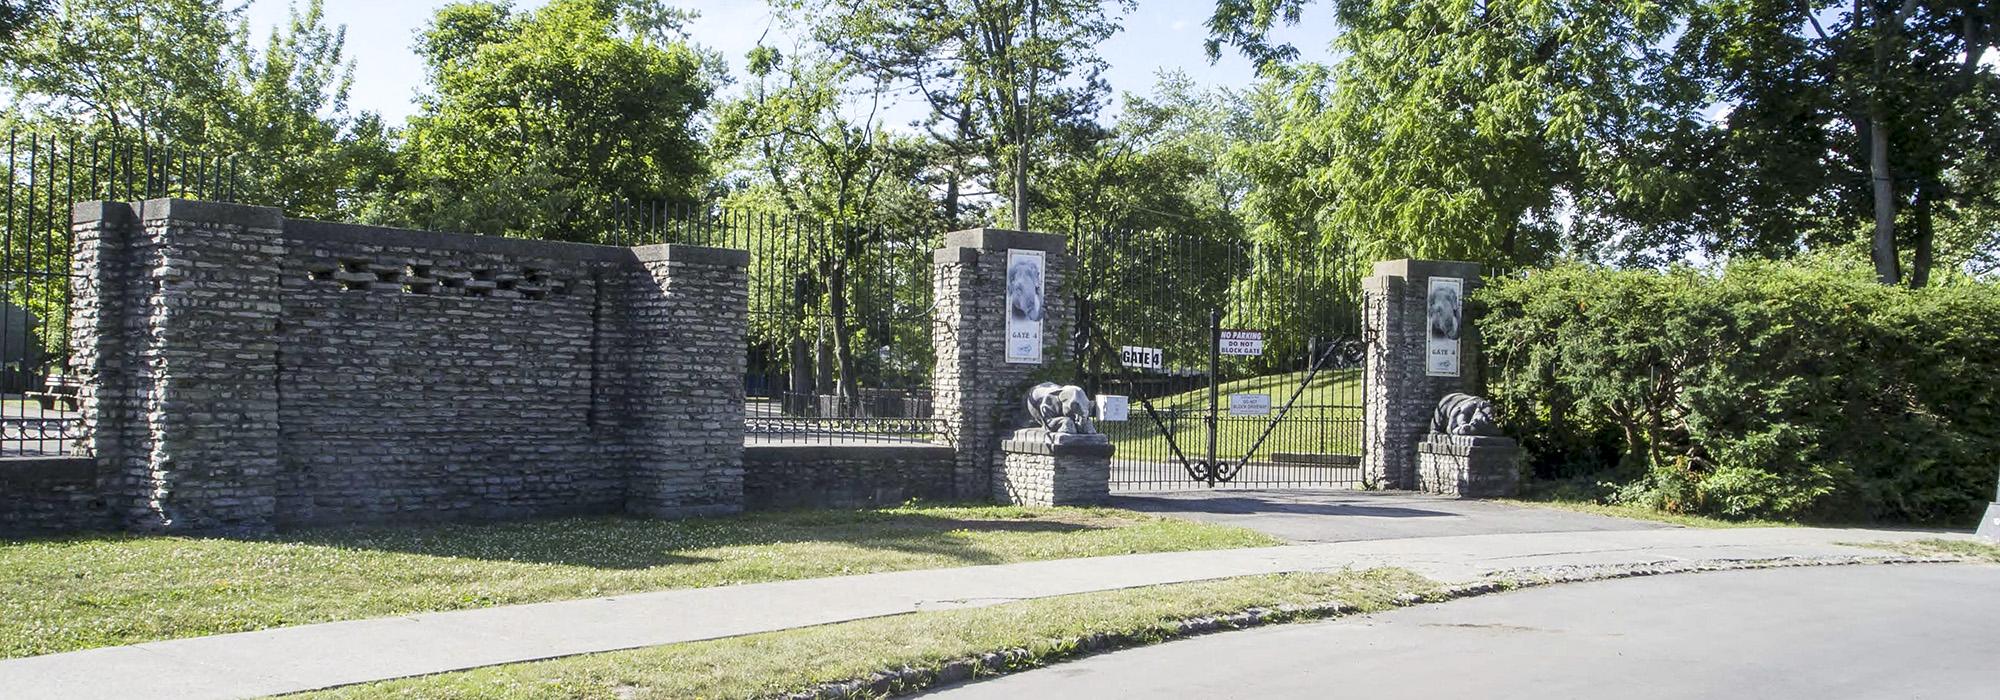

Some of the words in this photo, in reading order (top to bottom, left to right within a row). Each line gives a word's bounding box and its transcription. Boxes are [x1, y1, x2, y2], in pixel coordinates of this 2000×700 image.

[1220, 331, 1232, 339] NO
[1232, 331, 1262, 340] PARKING
[1123, 351, 1150, 364] GATE
[1153, 353, 1160, 365] 4
